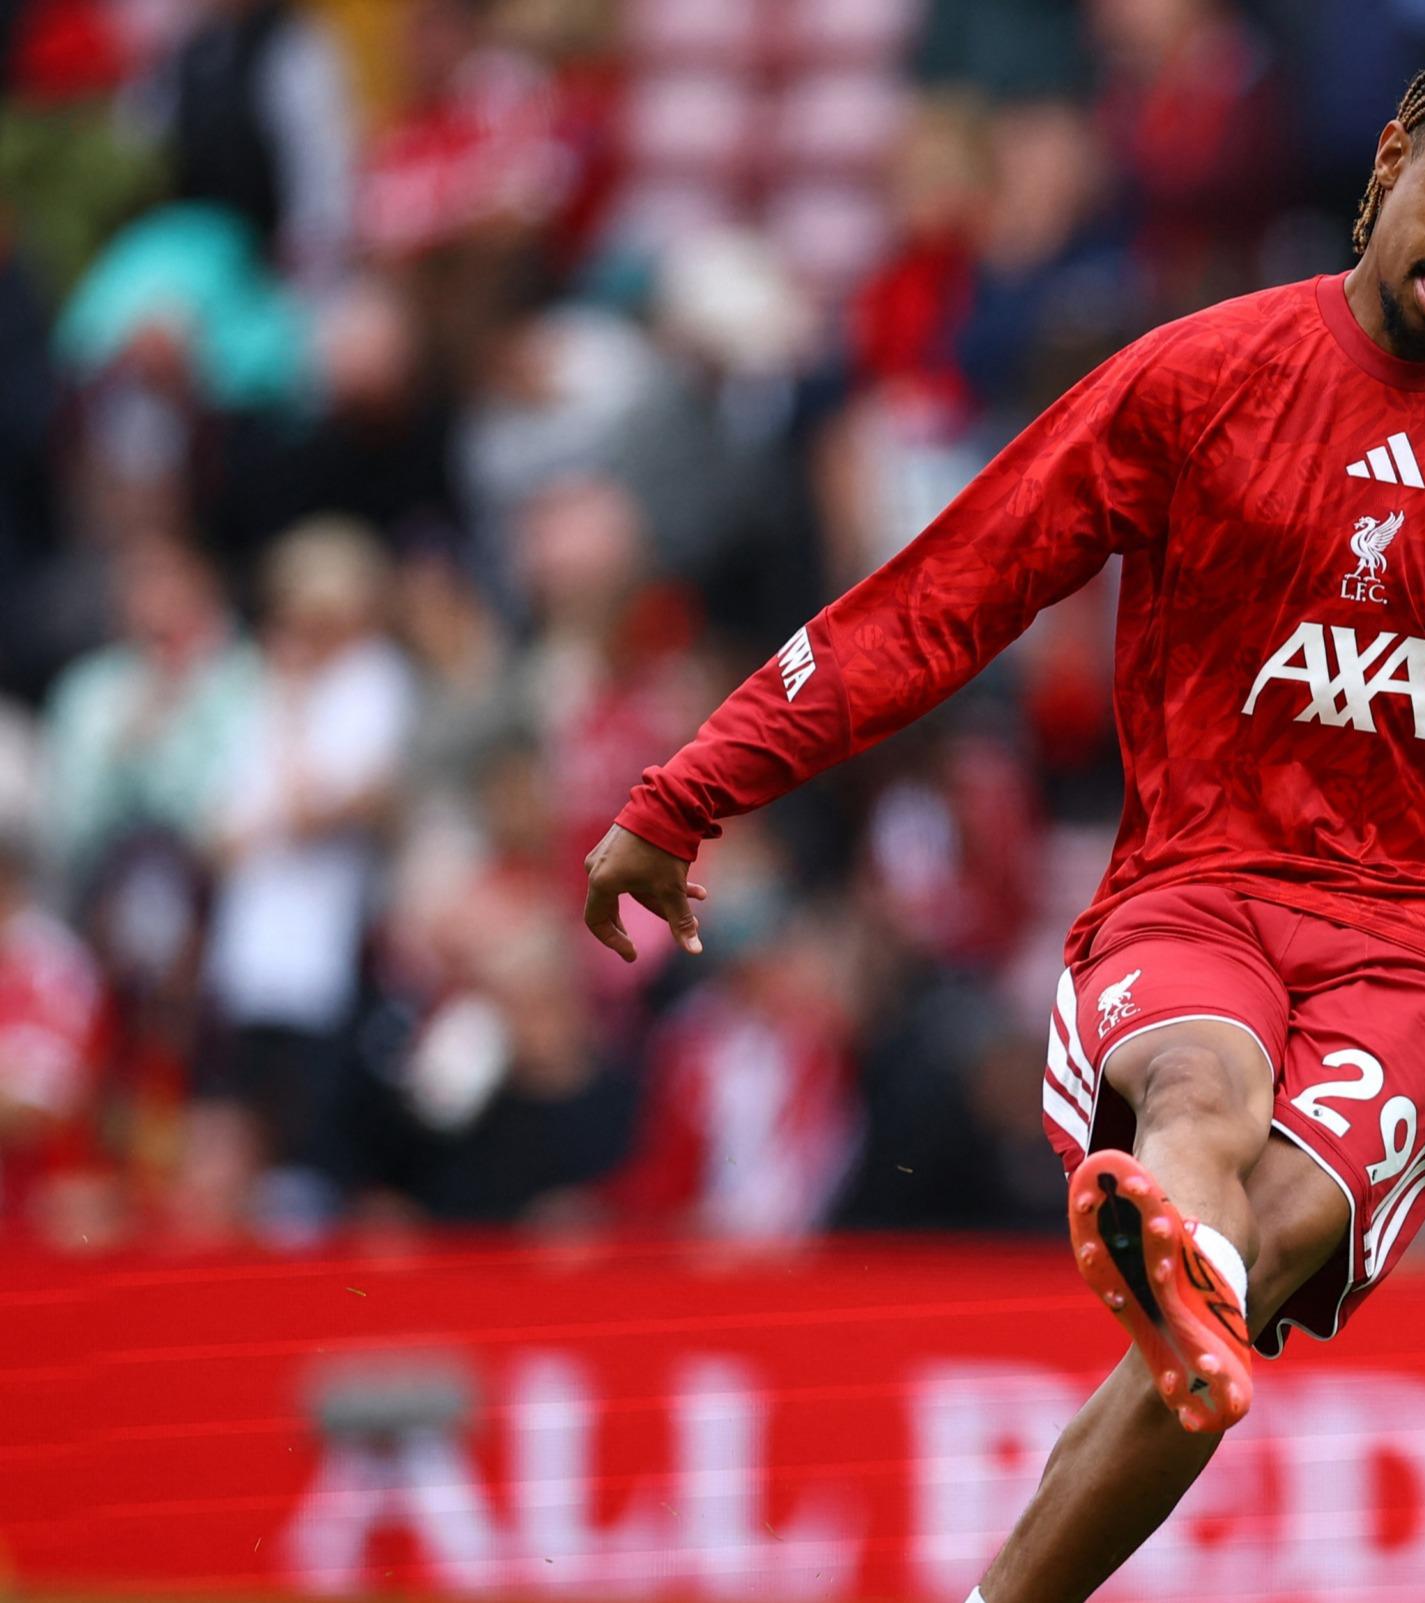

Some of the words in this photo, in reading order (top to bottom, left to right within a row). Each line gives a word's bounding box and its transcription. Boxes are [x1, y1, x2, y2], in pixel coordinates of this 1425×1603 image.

[1340, 579, 1388, 604] L.F.C.
[1290, 1048, 1417, 1186] 29
[285, 1348, 868, 1600] ALL
